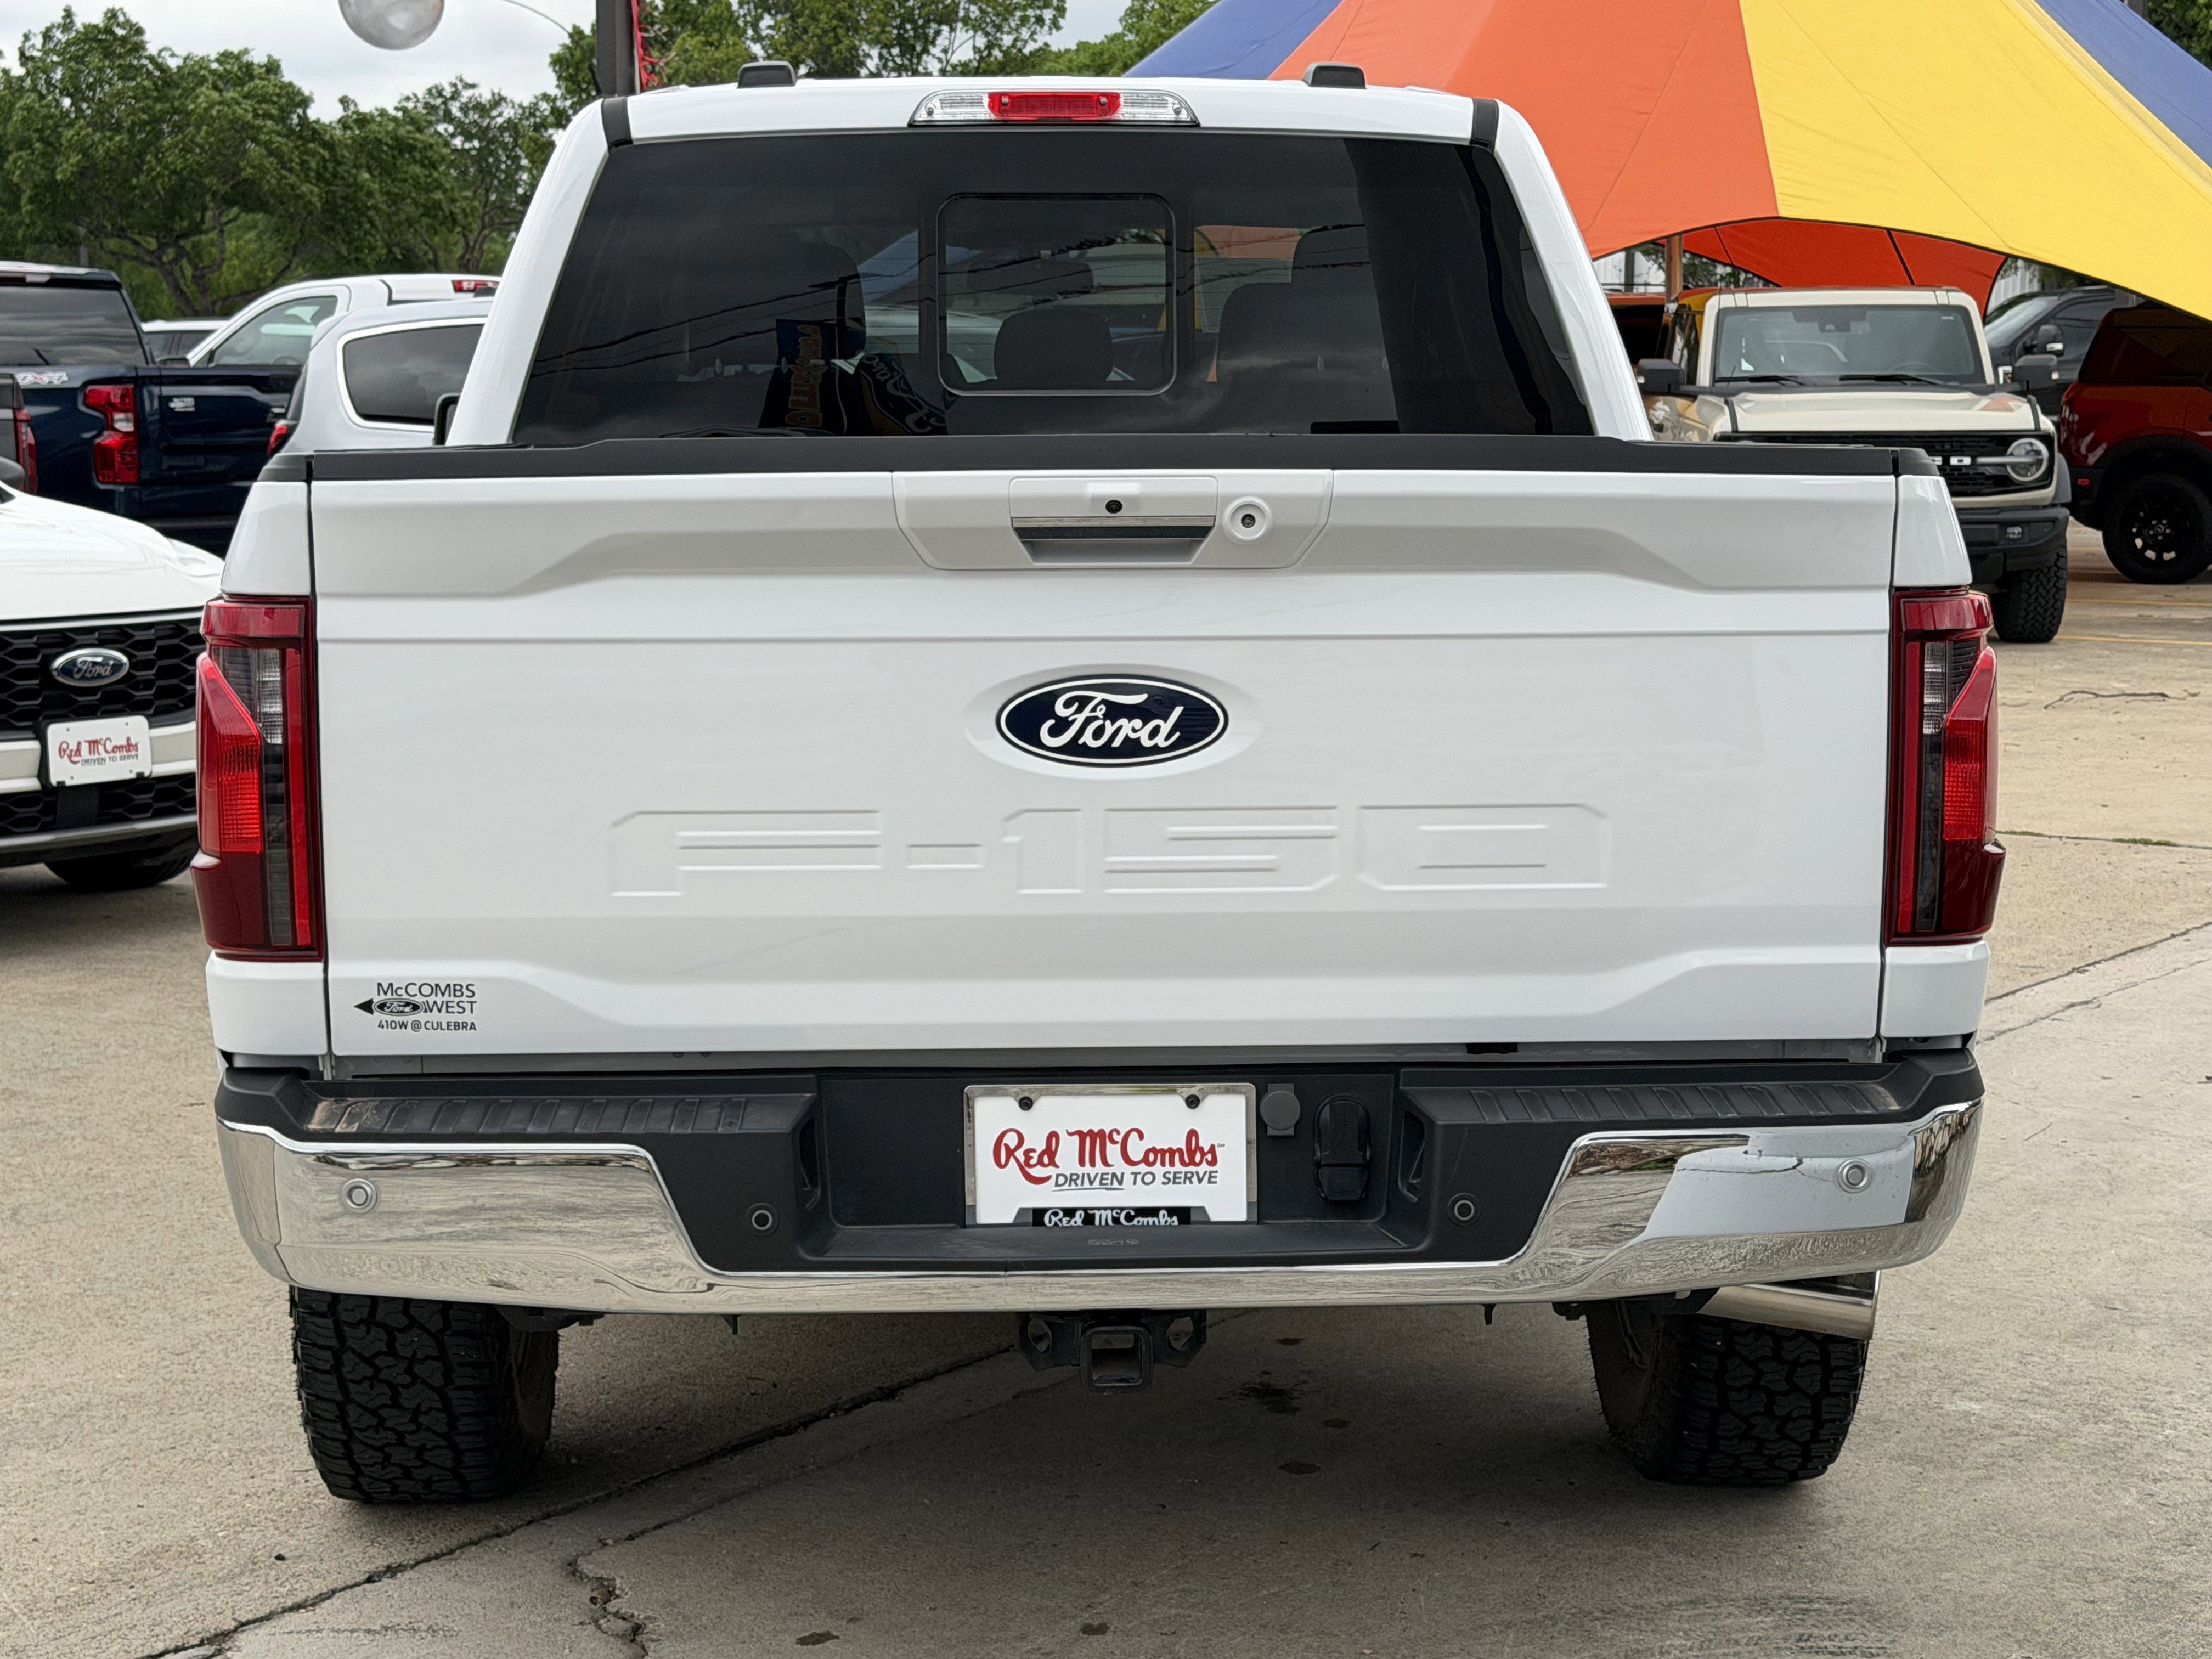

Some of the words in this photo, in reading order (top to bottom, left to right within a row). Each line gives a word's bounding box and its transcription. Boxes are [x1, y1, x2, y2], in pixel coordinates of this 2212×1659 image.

[73, 657, 114, 679] Ford
[1040, 690, 1184, 748] Ford
[58, 741, 82, 765] Red
[84, 736, 139, 755] McCombs
[609, 804, 1611, 896] F-150
[377, 982, 476, 998] McCOMBS
[384, 1002, 413, 1013] Ford
[426, 1000, 477, 1014] WEST
[424, 1020, 477, 1031] CULEBRA
[993, 1128, 1060, 1185] Red
[1066, 1128, 1217, 1168] McCombs
[1054, 1172, 1124, 1188] DRIVEN
[1130, 1171, 1156, 1186] TO
[1161, 1170, 1218, 1186] SERVE
[1044, 1209, 1084, 1227] Red
[1087, 1209, 1178, 1227] McCombs
